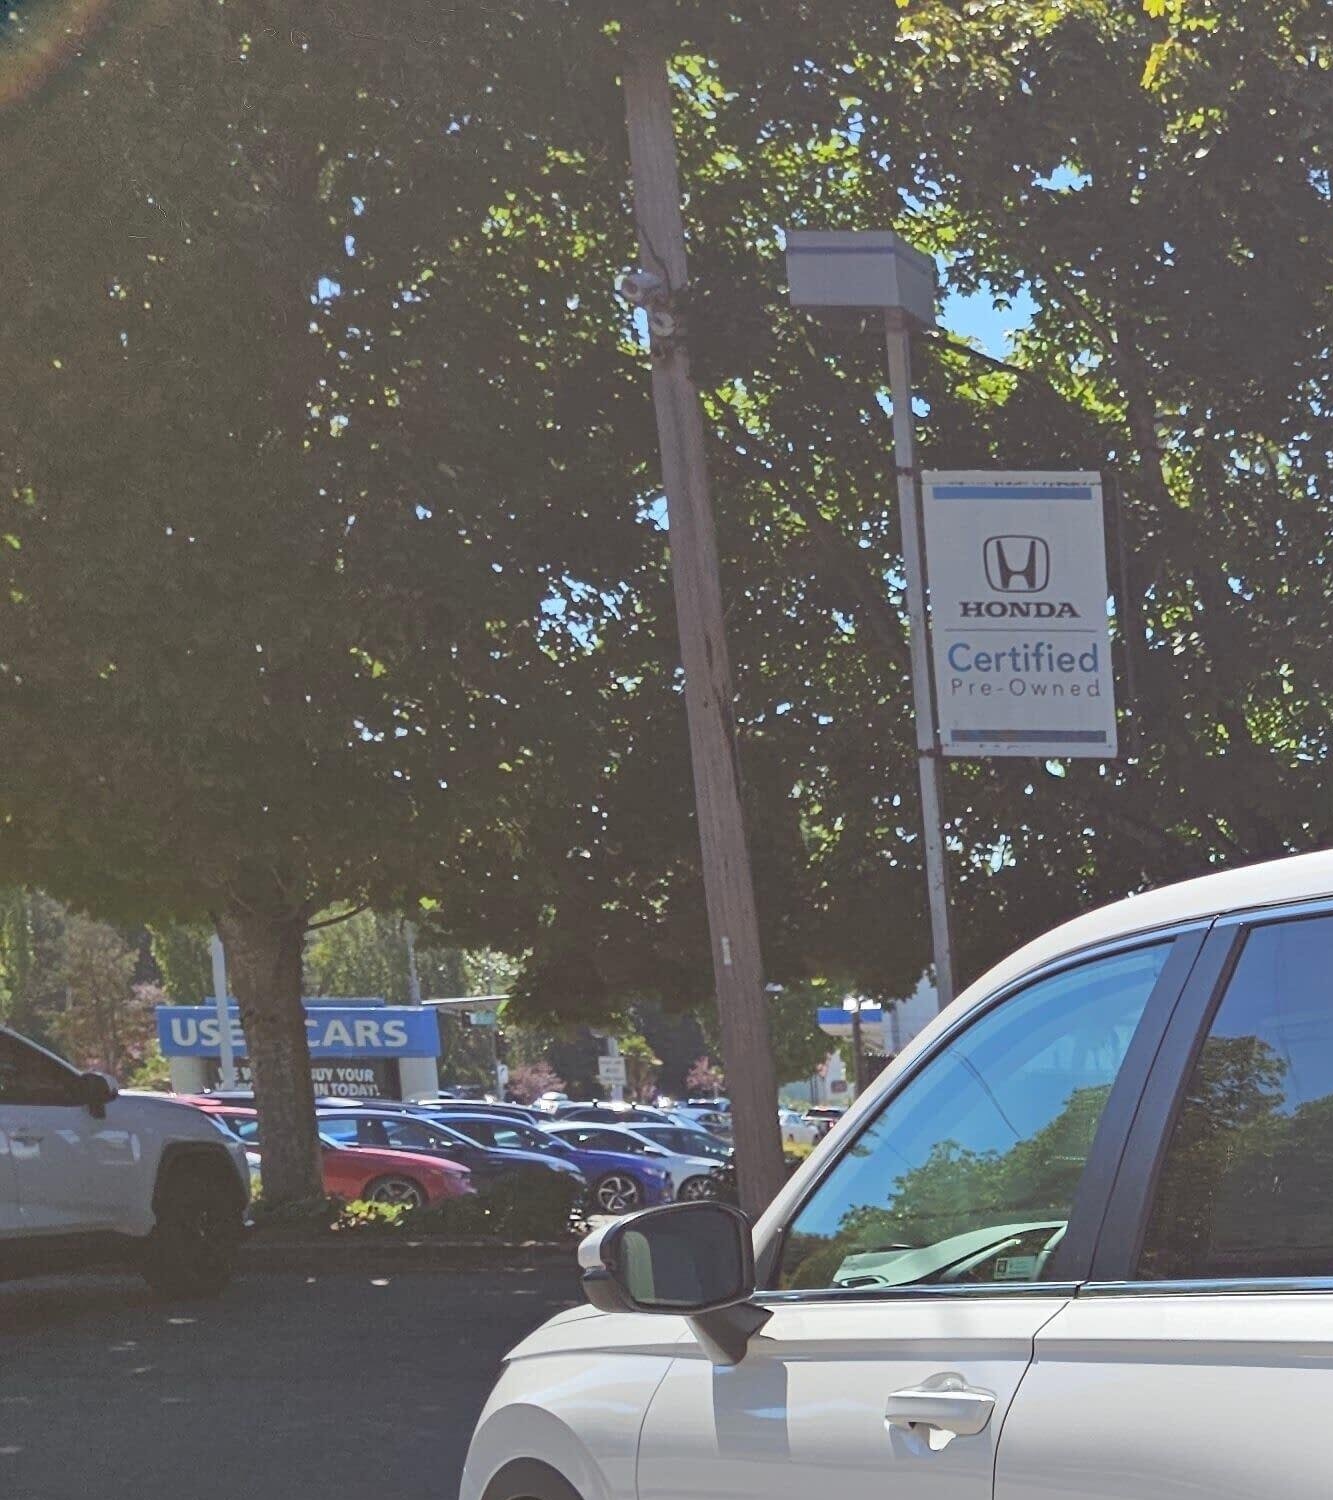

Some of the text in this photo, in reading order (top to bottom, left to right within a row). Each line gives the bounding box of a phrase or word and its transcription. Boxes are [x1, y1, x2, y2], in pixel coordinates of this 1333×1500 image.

[959, 601, 1081, 619] HONDA
[948, 642, 1099, 673] Certified
[952, 678, 1101, 697] Pre-Owned
[171, 1018, 408, 1047] USE CARS
[336, 1067, 374, 1082] YOUR
